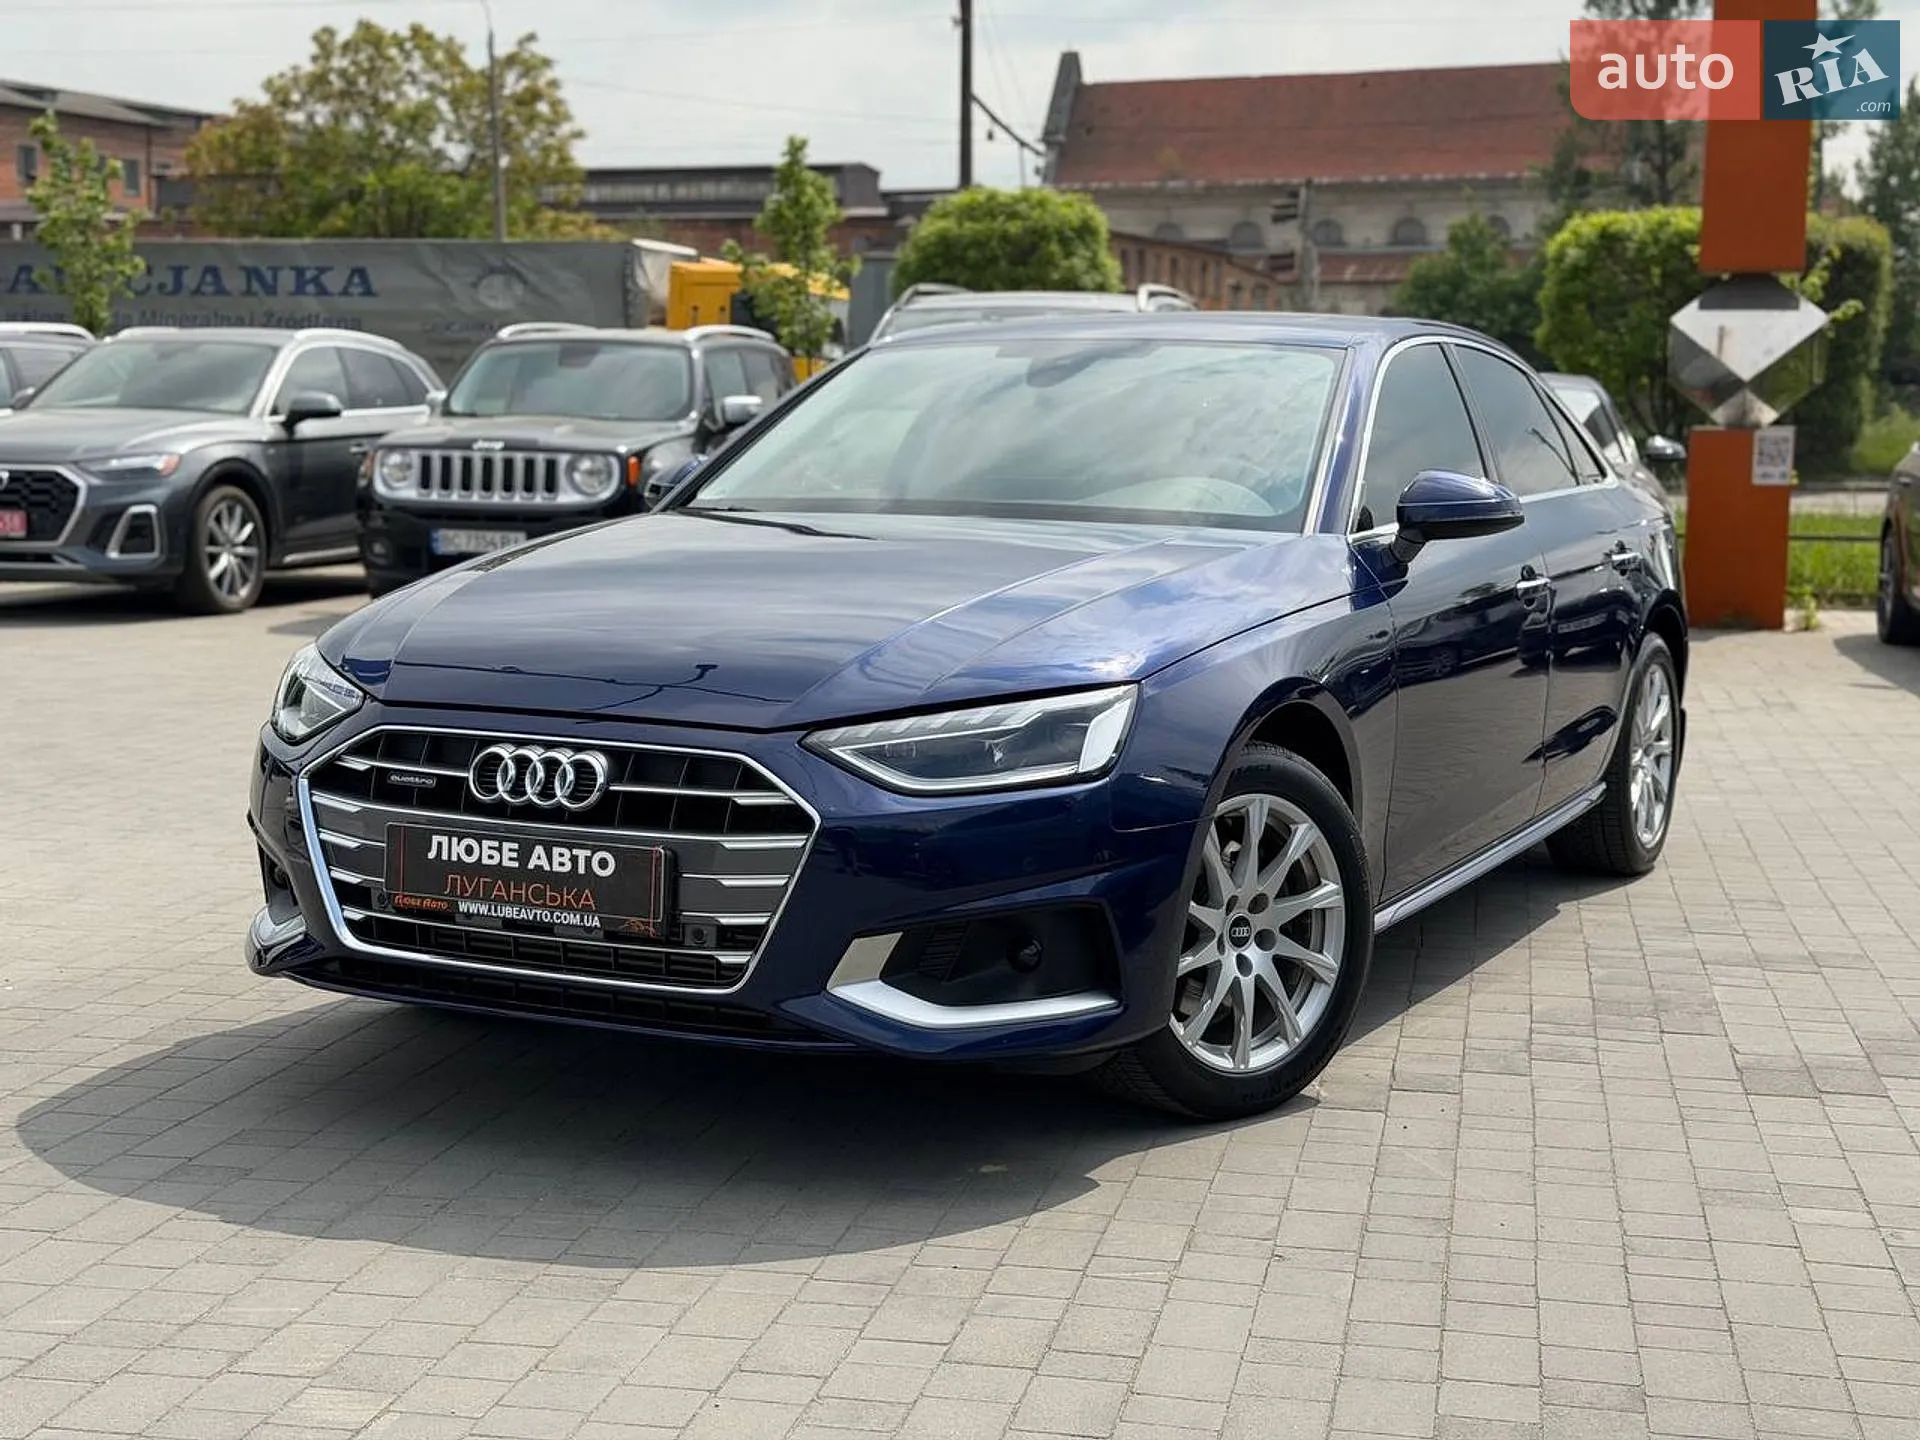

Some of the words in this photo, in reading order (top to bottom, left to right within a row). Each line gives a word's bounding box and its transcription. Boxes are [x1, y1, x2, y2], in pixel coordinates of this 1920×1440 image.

[427, 834, 520, 868] ЛЮБЕ
[527, 844, 616, 877] АВТО
[443, 873, 597, 912] ЛУГАНСЬКА
[458, 901, 601, 928] WWW.LUBEAVTO.COM.UA
